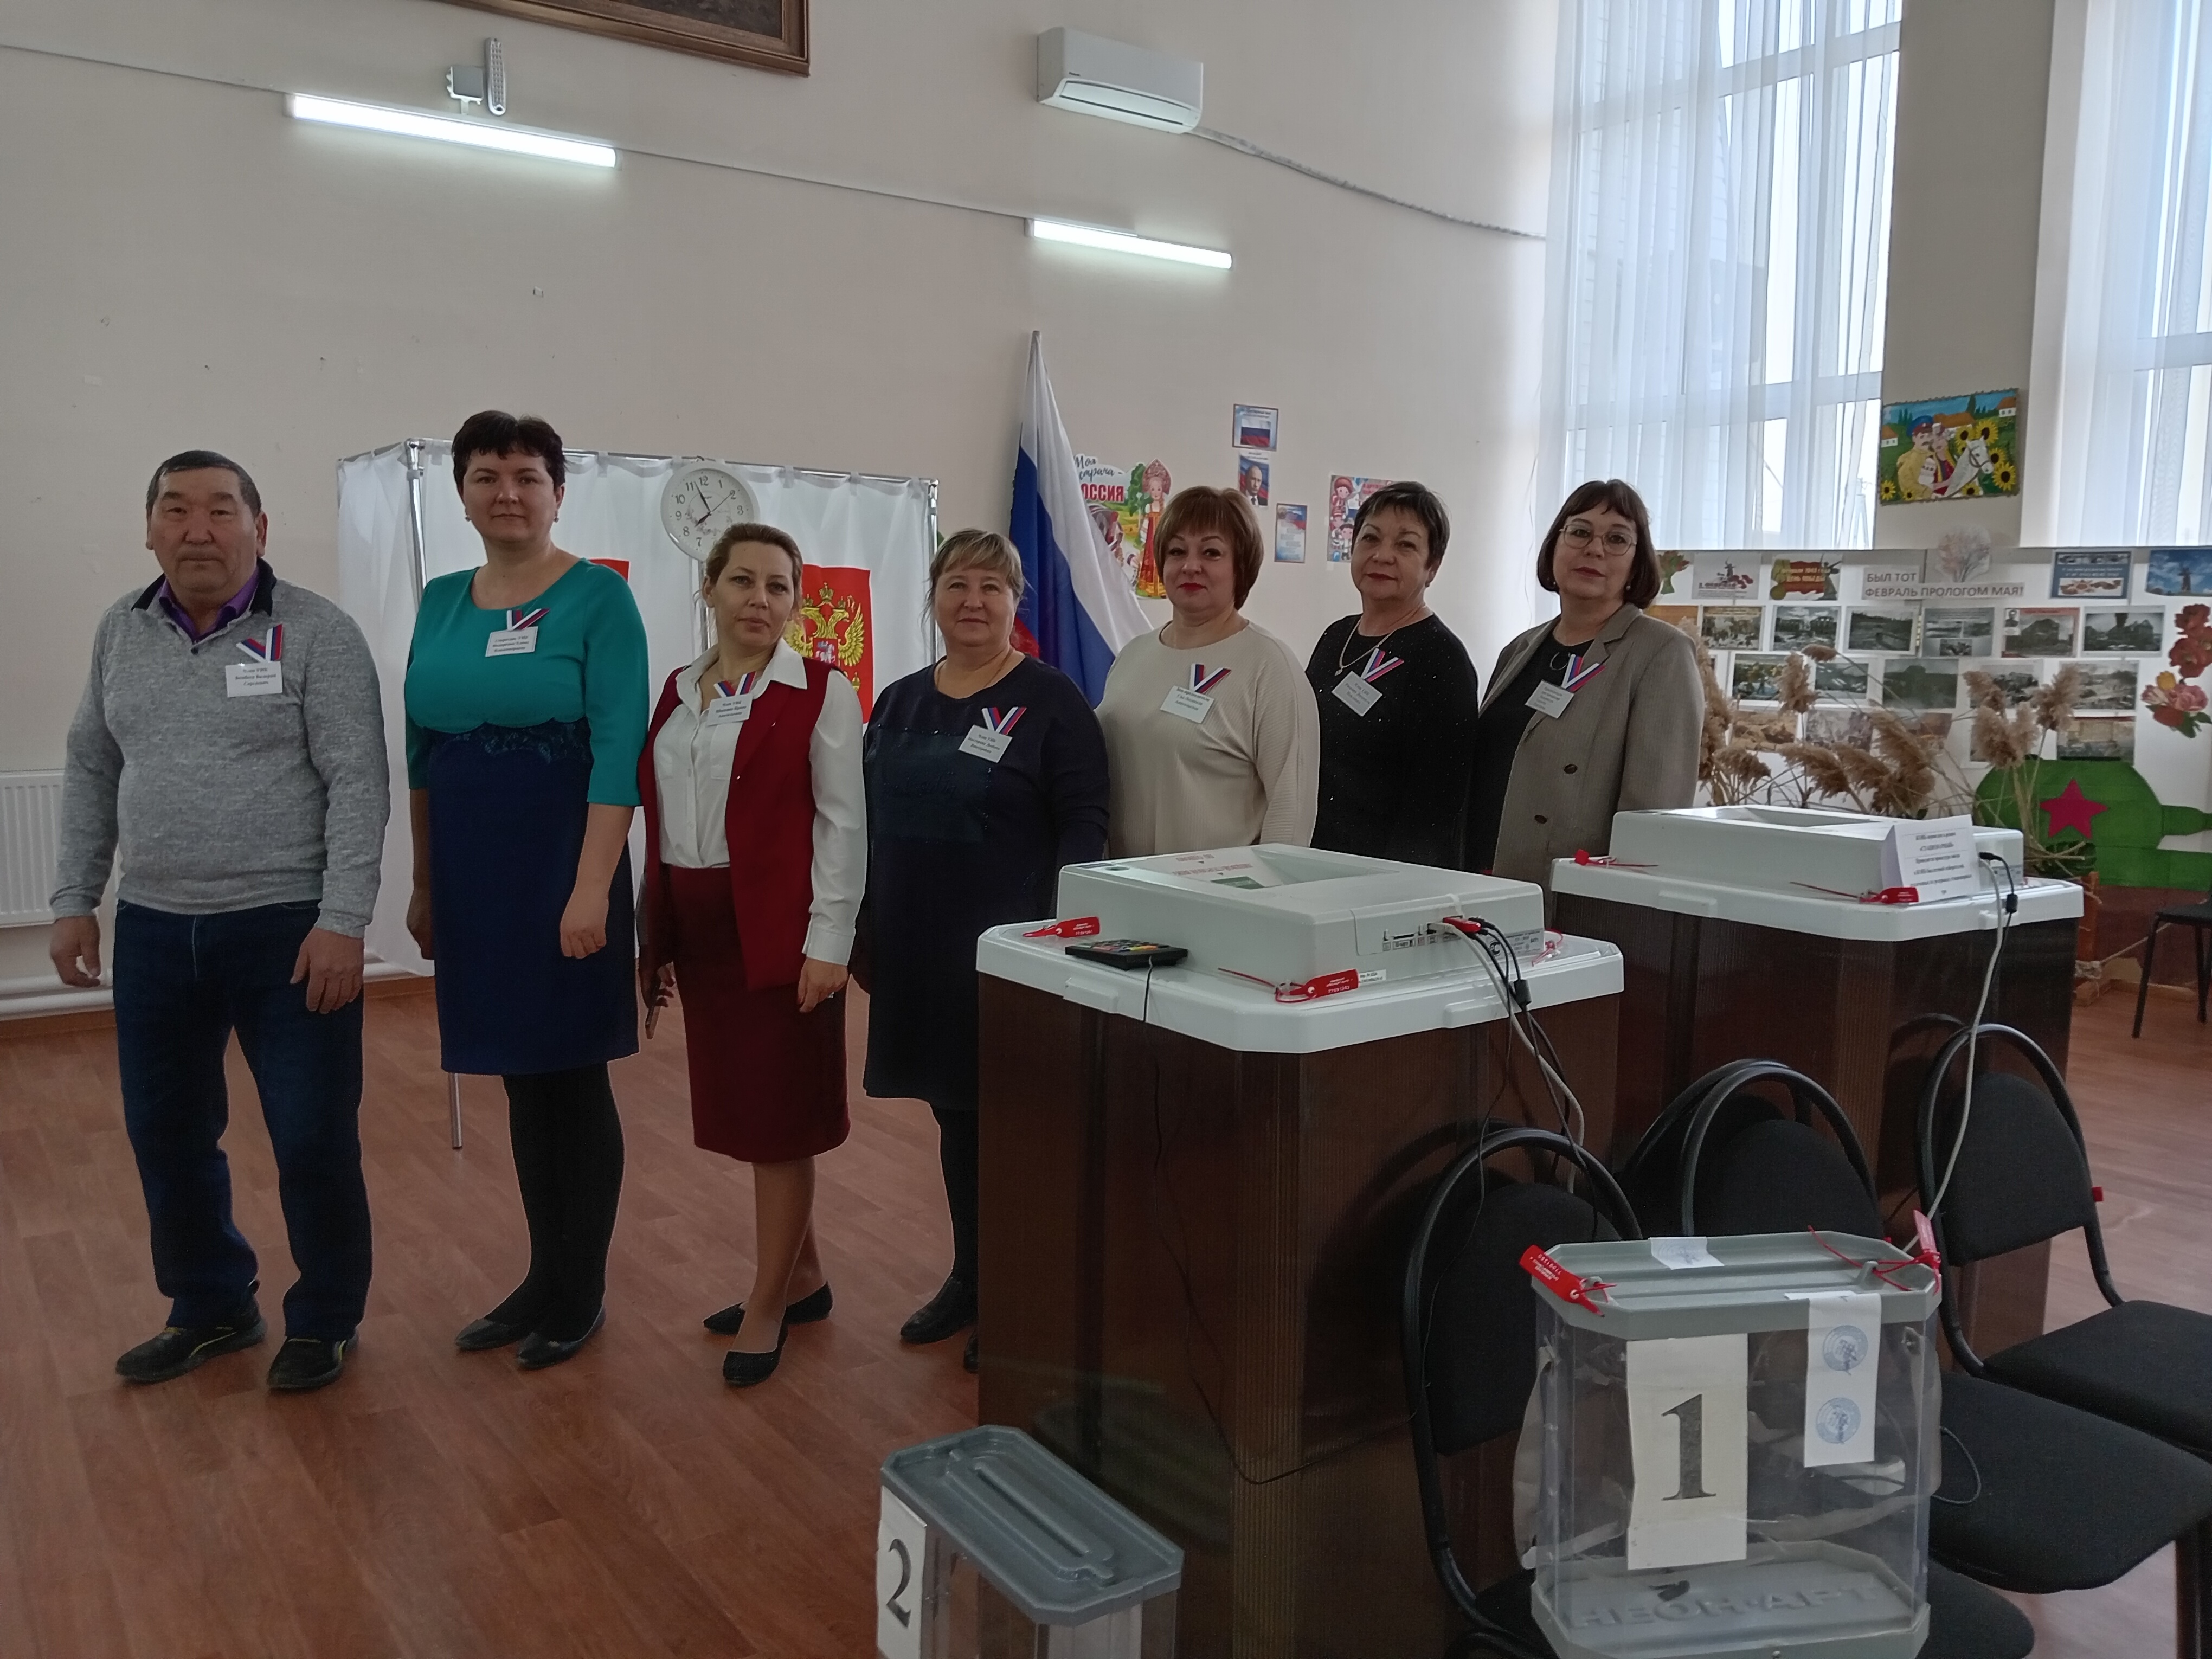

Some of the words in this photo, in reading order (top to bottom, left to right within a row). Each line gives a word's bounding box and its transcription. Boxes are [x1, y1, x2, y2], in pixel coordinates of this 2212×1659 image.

[1075, 455, 1097, 470] Моя
[1079, 467, 1116, 482] страна
[699, 475, 709, 486] 12
[718, 479, 723, 488] 1
[686, 481, 694, 491] 11
[729, 490, 737, 500] 2
[1081, 483, 1124, 502] ОССИЯ
[675, 494, 685, 504] 10
[737, 505, 744, 515] 3
[676, 510, 682, 521] 9
[683, 526, 690, 536] 8
[696, 537, 702, 547] 7
[1867, 573, 1892, 582] БЫЛ
[1895, 573, 1917, 582] ТОТ
[1864, 588, 1918, 597] ФЕВРАЛЬ
[1921, 587, 1989, 597] ПРОЛОГОМ
[1661, 1393, 1717, 1501] 1
[885, 1538, 912, 1628] 2
